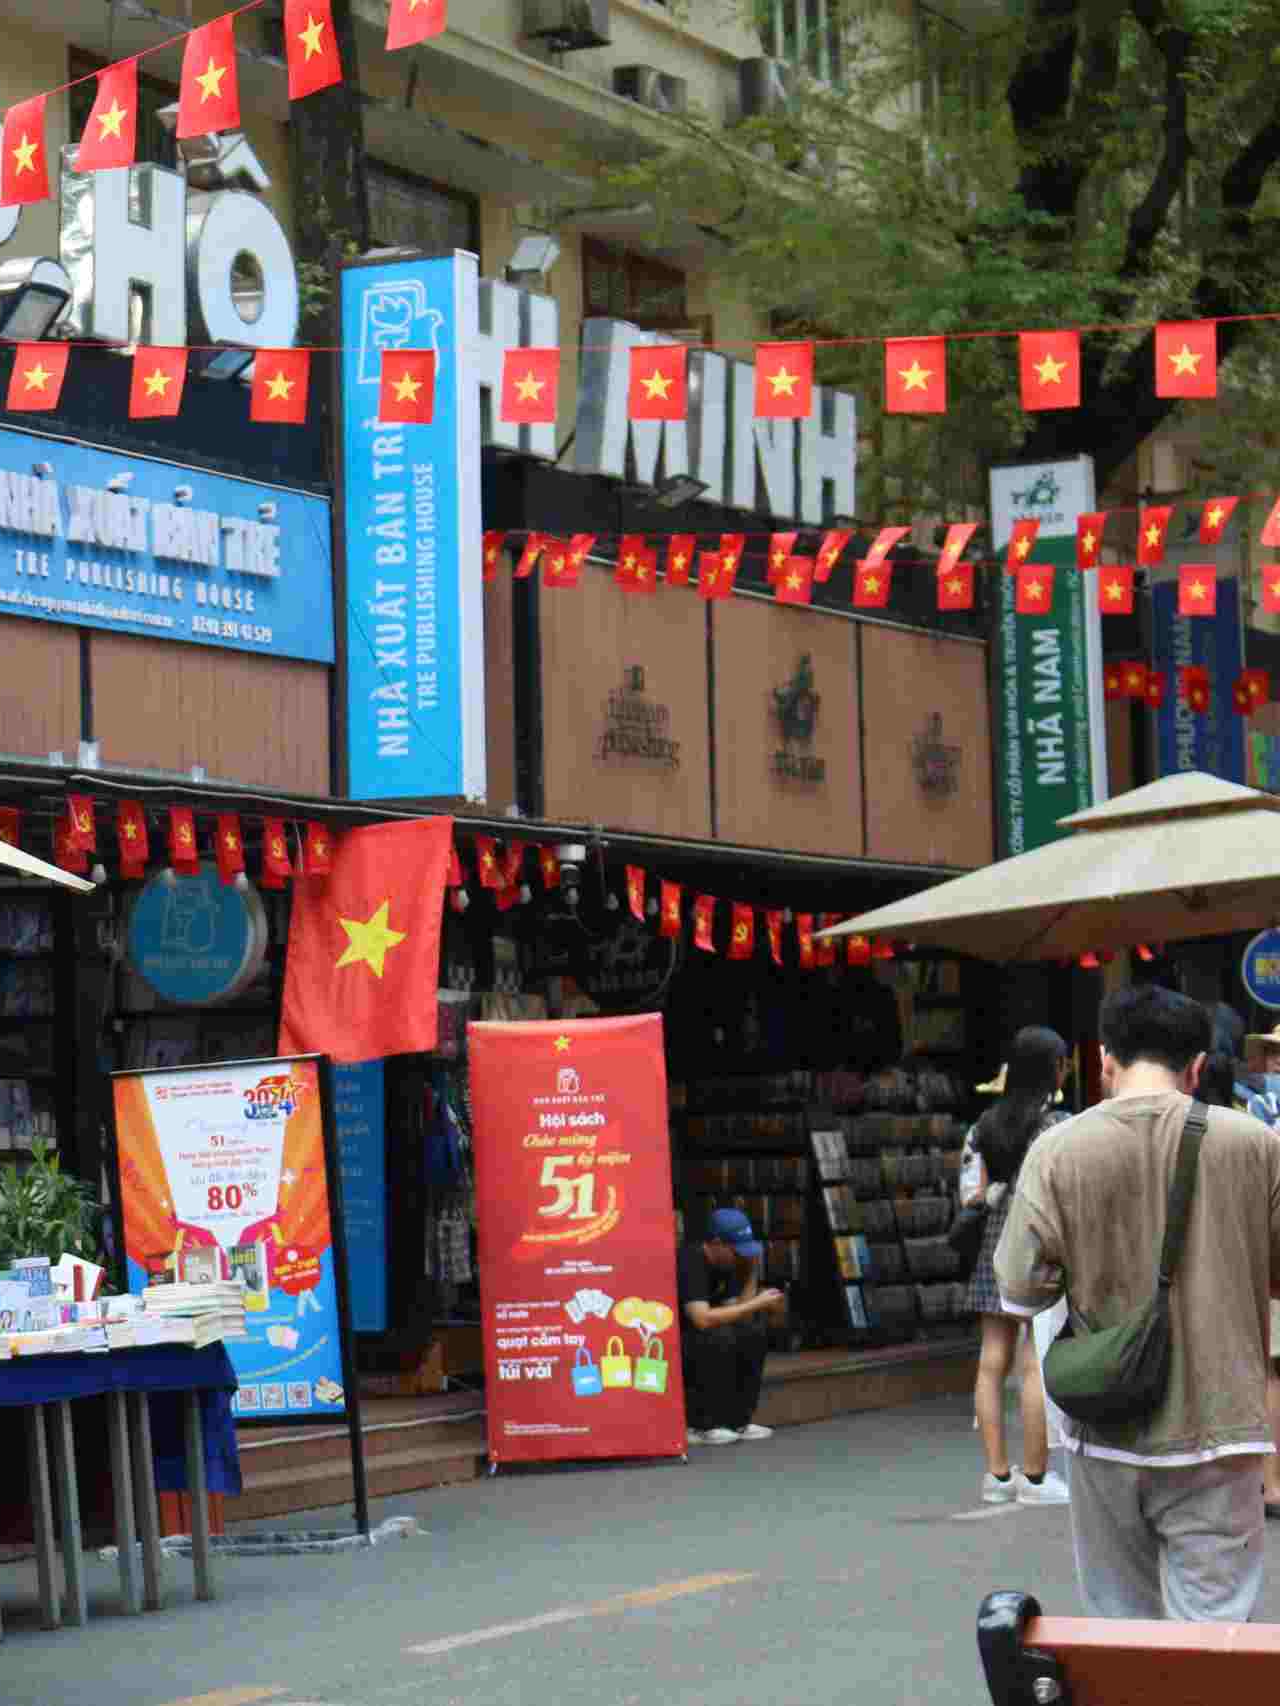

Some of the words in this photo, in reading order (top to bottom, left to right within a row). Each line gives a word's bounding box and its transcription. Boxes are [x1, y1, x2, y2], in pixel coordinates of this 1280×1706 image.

[366, 491, 407, 565] BẢN
[414, 463, 436, 532] HOUSE
[367, 580, 407, 666] XUẤT
[416, 537, 437, 664] PUBLISHING
[1031, 627, 1061, 703] NAM
[370, 681, 408, 756] NHÀ
[1027, 711, 1066, 786] NHÃ
[208, 1183, 258, 1211] 80%
[538, 1155, 597, 1219] 51
